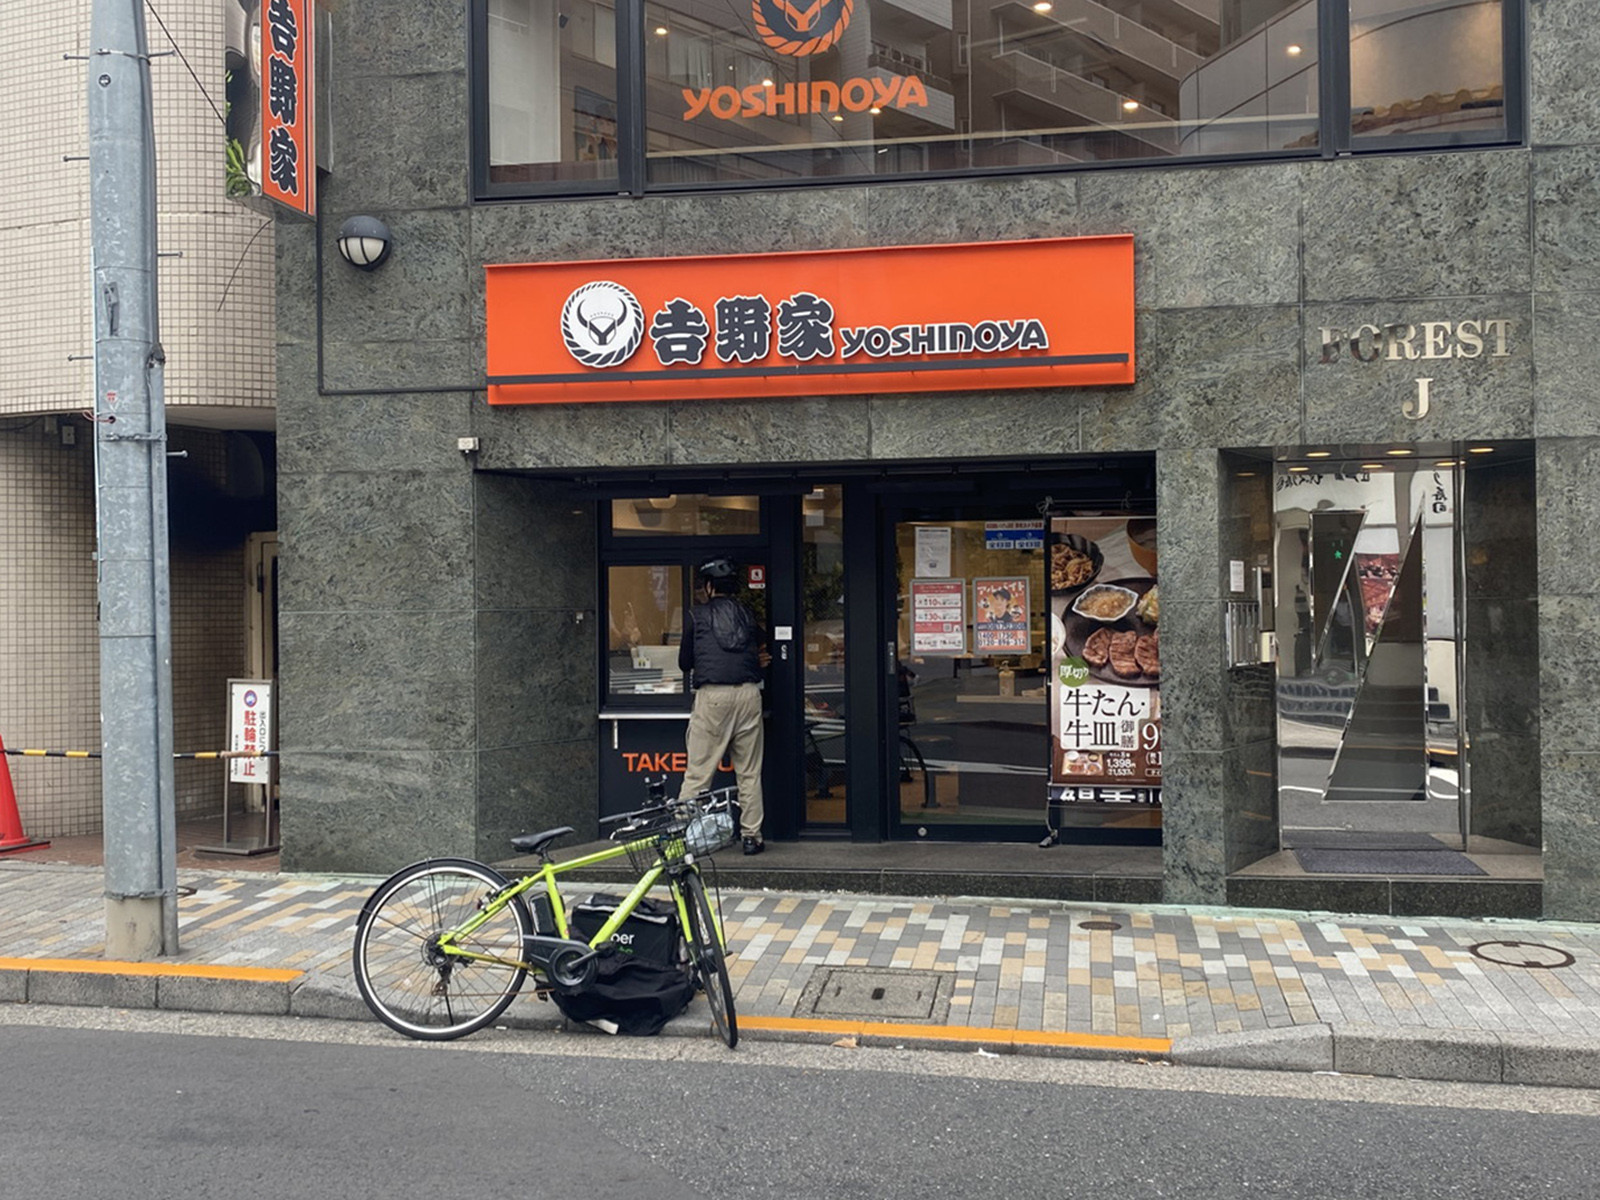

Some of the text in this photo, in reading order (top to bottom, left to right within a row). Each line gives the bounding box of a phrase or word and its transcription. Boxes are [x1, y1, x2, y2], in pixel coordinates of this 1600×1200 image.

[682, 75, 928, 121] YOSHINOYA
[649, 291, 1049, 366] 吉野家 YOSHINOYA
[1318, 319, 1513, 364] FOREST
[1402, 378, 1433, 420] J
[1063, 719, 1119, 748] 牛皿
[622, 753, 688, 772] TAKE
